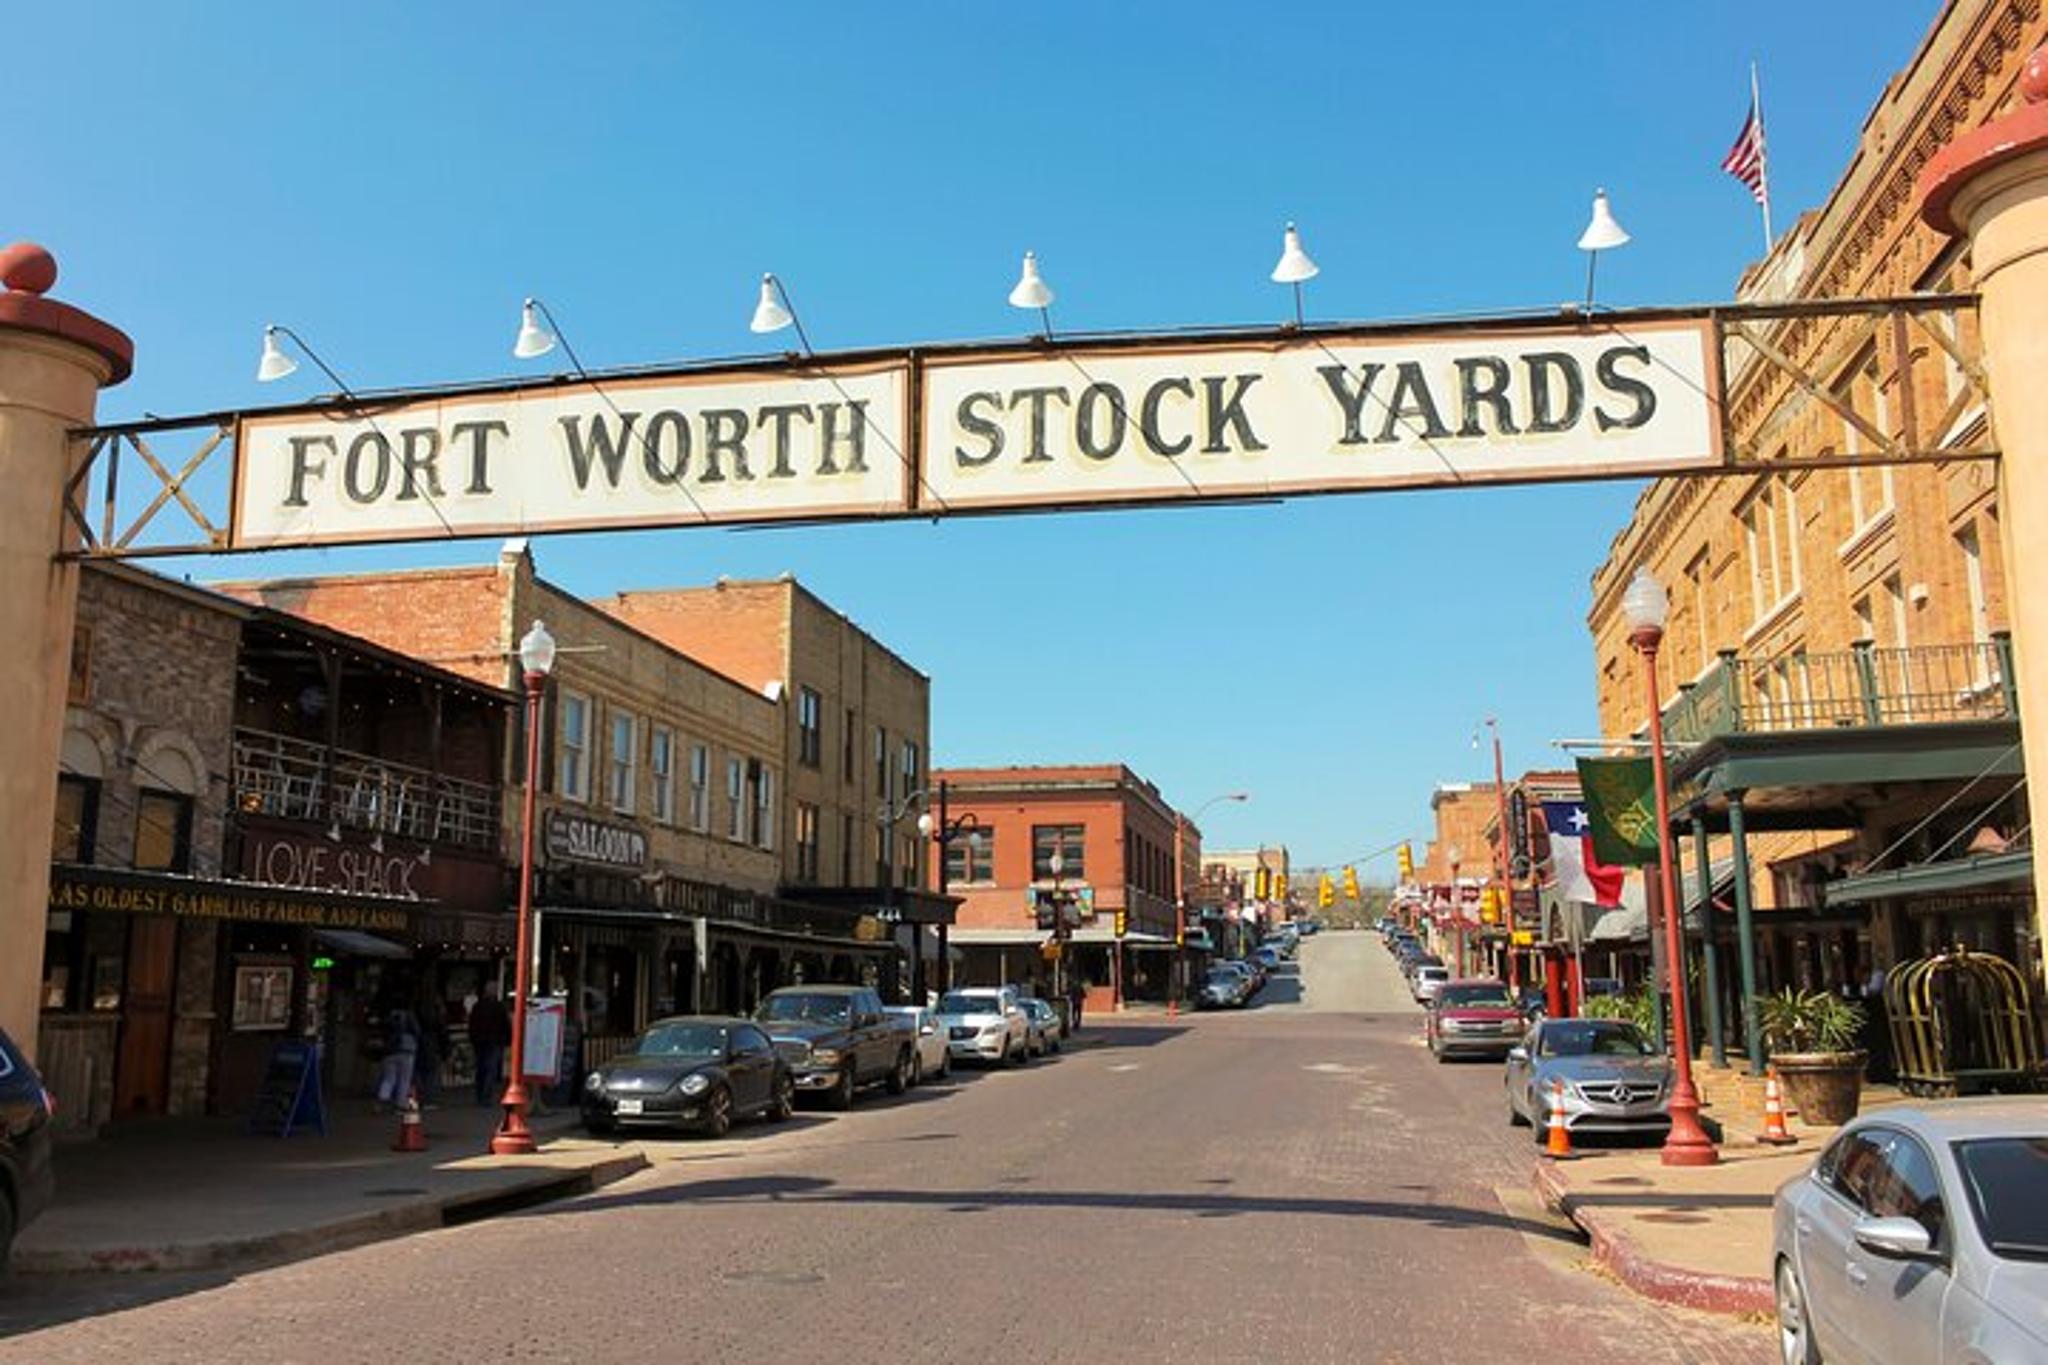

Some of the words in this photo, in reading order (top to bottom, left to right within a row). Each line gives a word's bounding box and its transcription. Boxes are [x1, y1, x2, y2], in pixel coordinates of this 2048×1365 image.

[282, 421, 510, 507] FORT
[558, 399, 870, 490] WORTH
[955, 374, 1268, 467] STOCK
[1316, 345, 1657, 445] YARDS
[567, 820, 630, 863] SALOON
[255, 841, 328, 889] LOVE
[336, 850, 418, 901] SHACK
[93, 886, 168, 912] OLDEST
[171, 892, 260, 919] GAMBLING
[263, 898, 325, 925] PARLOR
